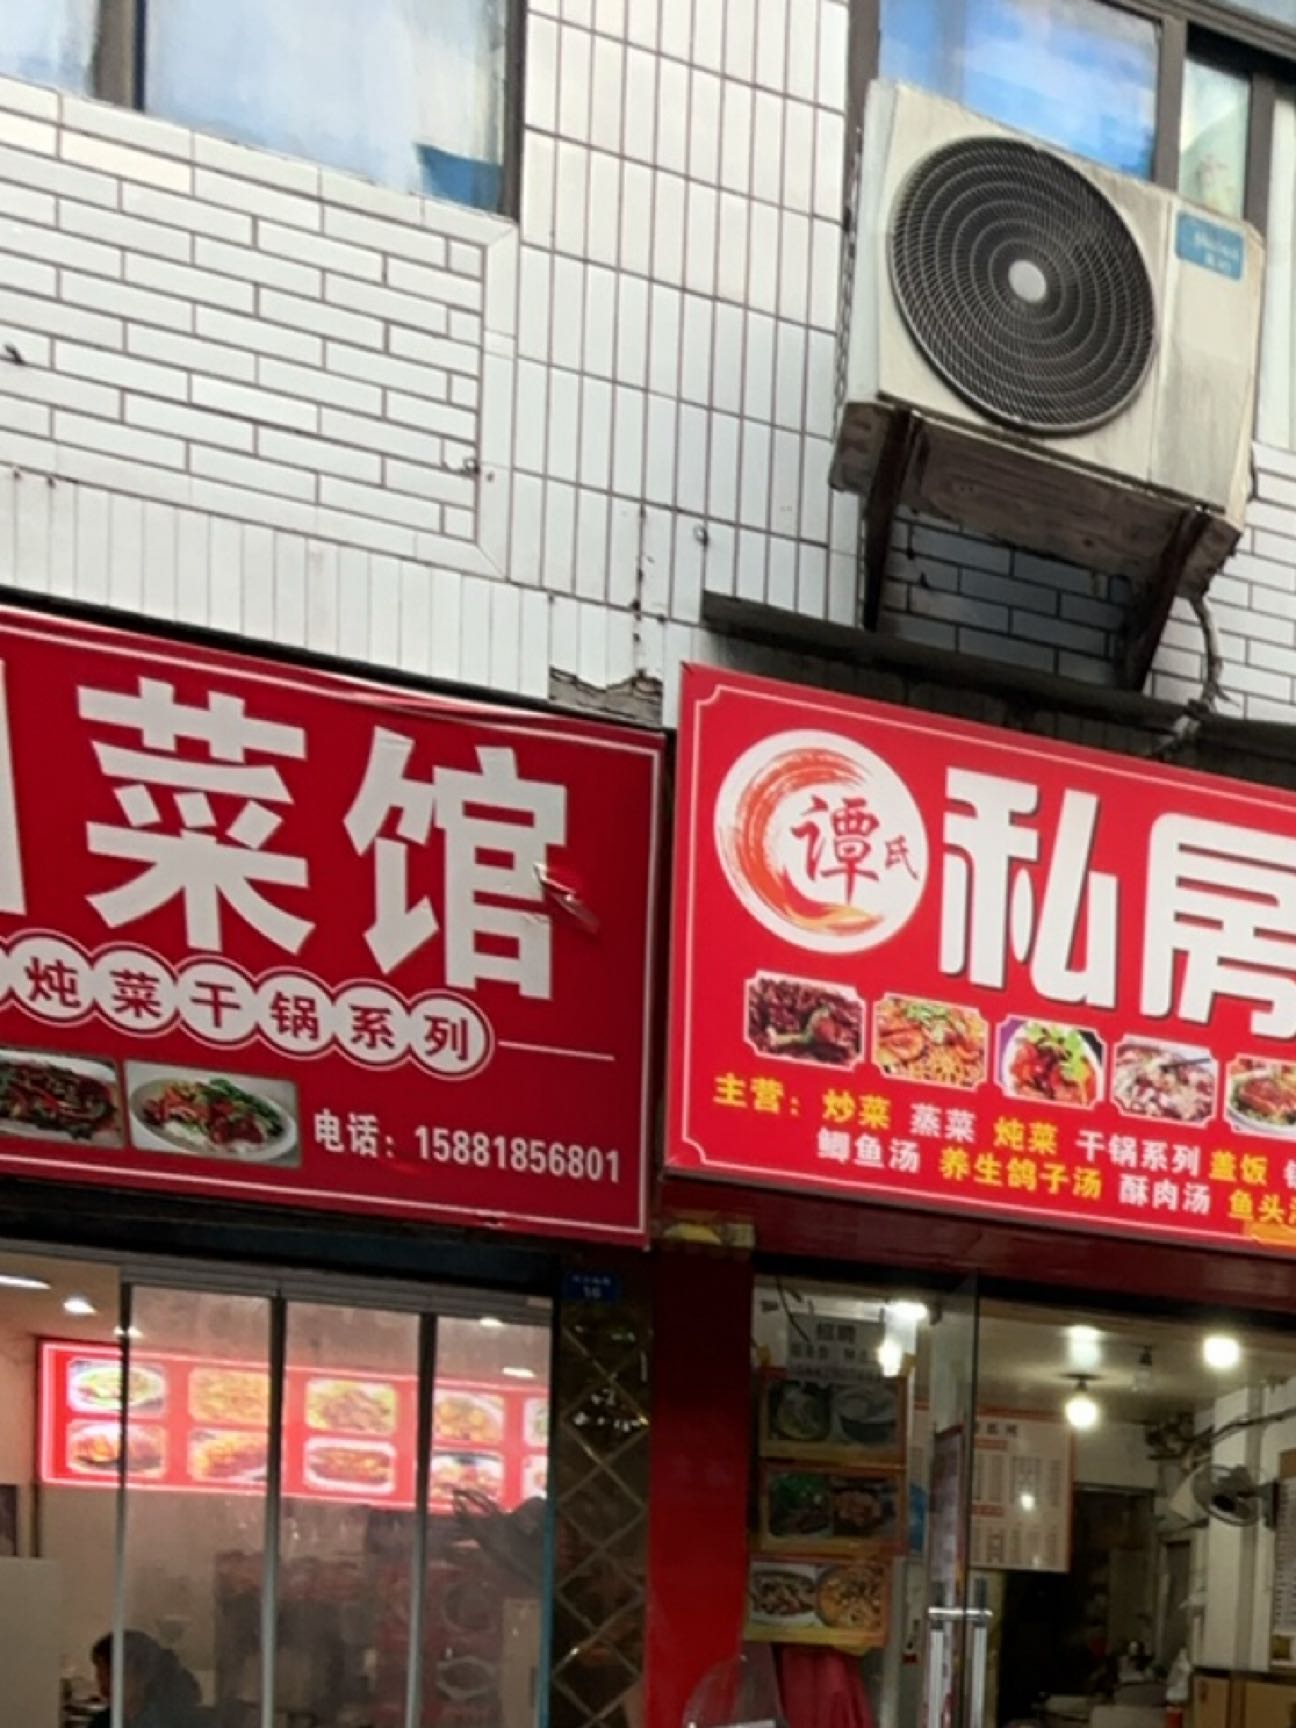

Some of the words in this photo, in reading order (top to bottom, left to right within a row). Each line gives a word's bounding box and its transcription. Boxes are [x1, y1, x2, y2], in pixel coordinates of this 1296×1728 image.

[23, 956, 469, 1063] 炖菜干锅系列
